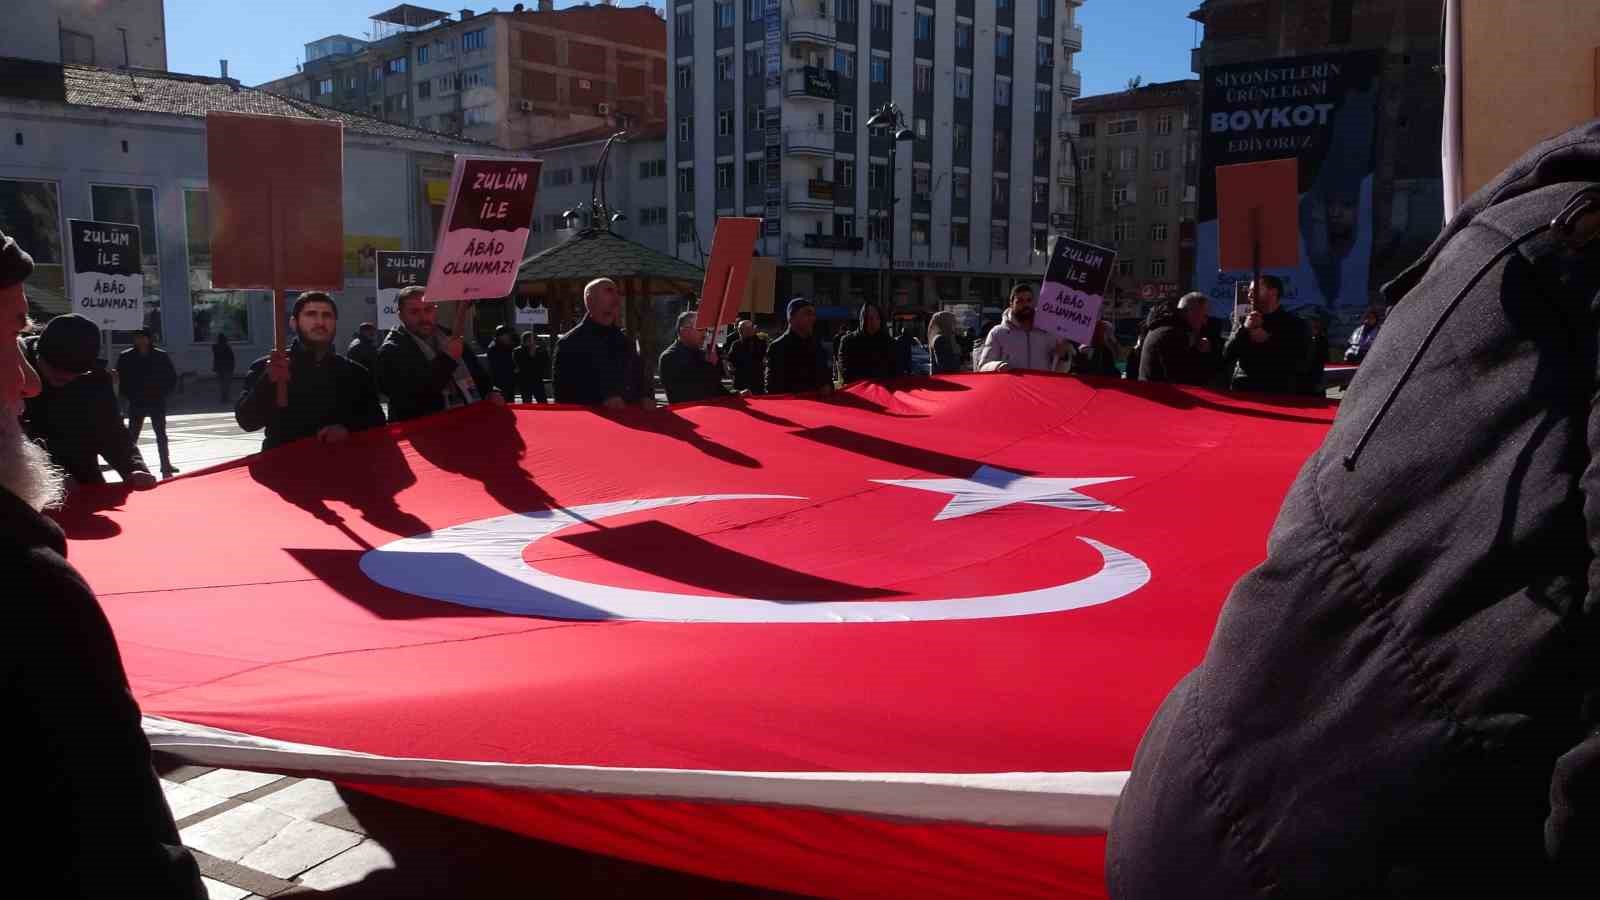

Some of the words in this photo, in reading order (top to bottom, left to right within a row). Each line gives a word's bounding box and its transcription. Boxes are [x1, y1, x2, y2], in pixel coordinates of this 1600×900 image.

[1210, 103, 1334, 132] BOYKOT
[472, 167, 528, 190] ZULÜM
[479, 197, 508, 219] İLE
[82, 228, 129, 246] ZULÜM
[98, 248, 120, 266] İLE
[386, 255, 425, 268] ZULÜM
[443, 259, 514, 275] OLUNMAZ!
[397, 271, 416, 284] İLE
[81, 297, 138, 309] OLUNMAZ!
